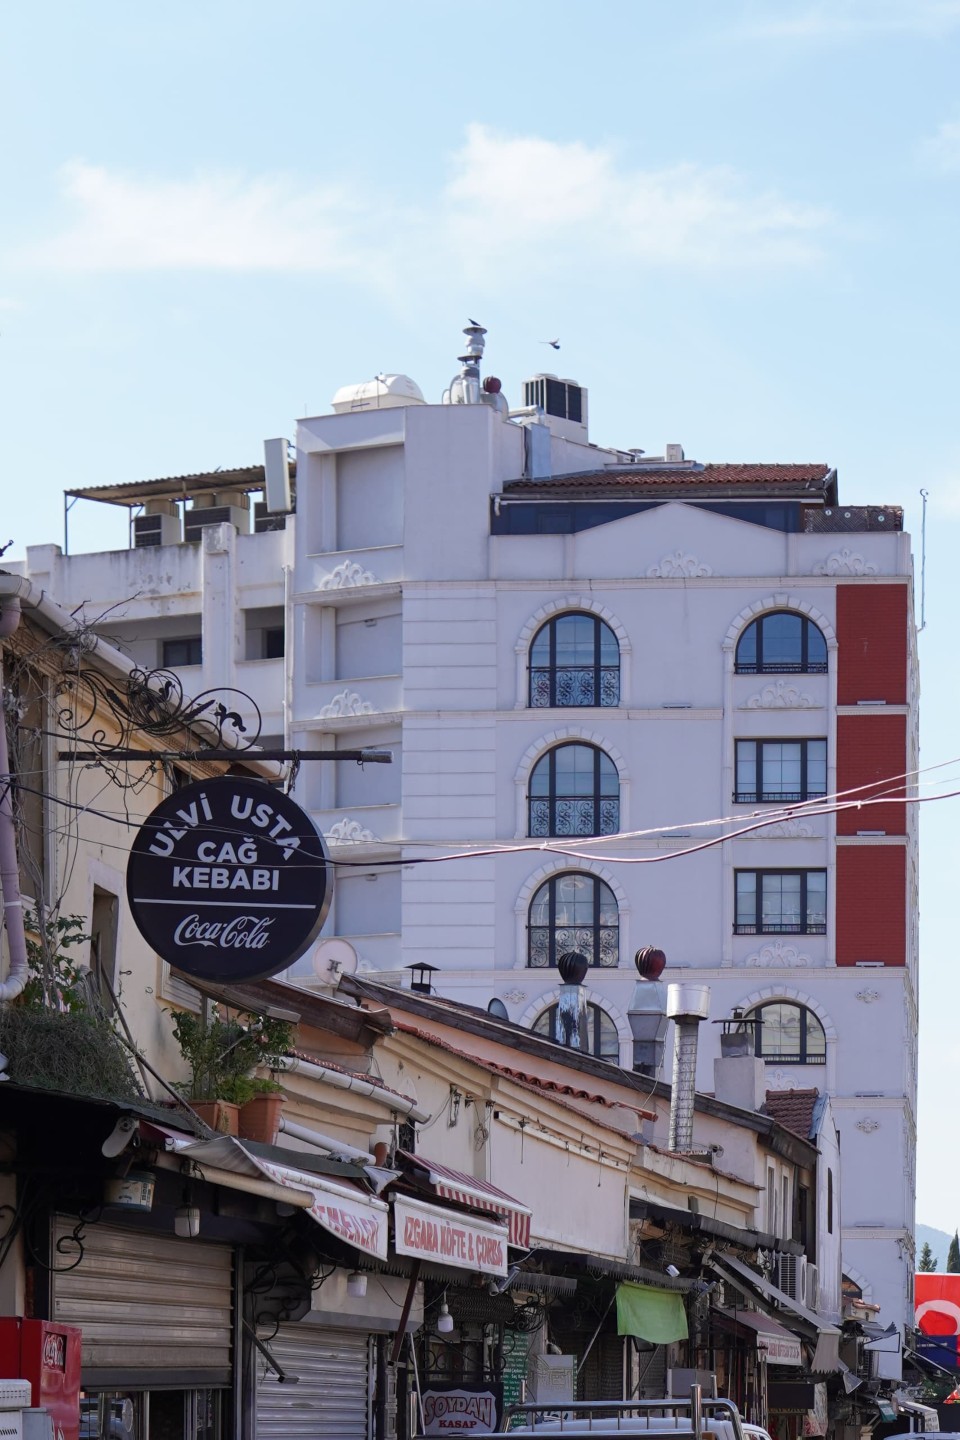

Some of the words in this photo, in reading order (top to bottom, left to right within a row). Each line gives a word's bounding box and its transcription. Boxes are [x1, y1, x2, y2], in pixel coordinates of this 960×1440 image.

[149, 793, 213, 857] ULVİ
[231, 795, 301, 861] USTA
[172, 866, 280, 891] KEBABI
[173, 913, 277, 949] Coca-Cola
[404, 1215, 438, 1252] IZGARA
[441, 1220, 466, 1258] KÖFTE
[476, 1234, 503, 1269] ÇORBA
[424, 1396, 492, 1428] SOYDAN
[438, 1420, 477, 1428] KASAP
